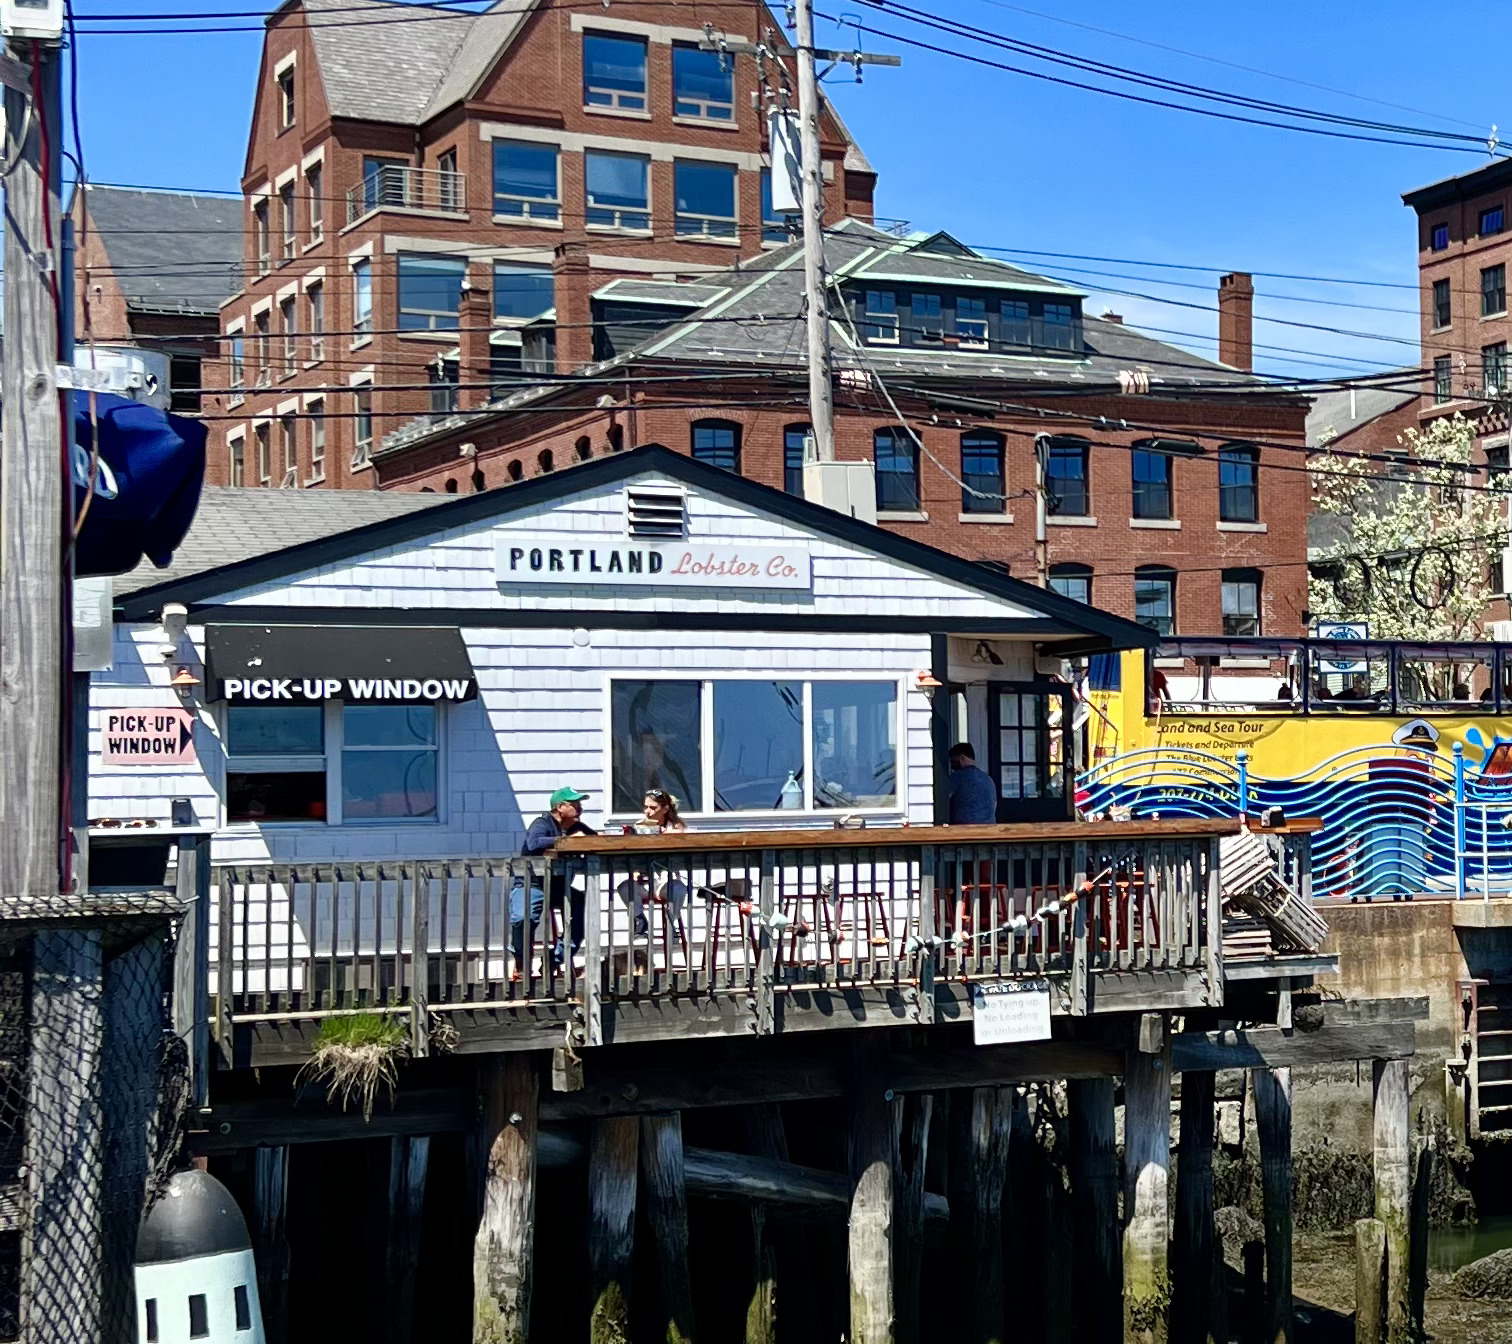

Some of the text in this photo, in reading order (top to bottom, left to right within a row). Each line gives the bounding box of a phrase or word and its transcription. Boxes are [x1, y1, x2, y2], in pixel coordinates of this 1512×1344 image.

[510, 547, 799, 578] PORTLAND Lobster Co.
[224, 678, 470, 700] PICK-UP WINDOW
[109, 715, 176, 734] PICK-UP
[1187, 720, 1212, 734] and
[1213, 721, 1235, 733] Sea
[1236, 720, 1264, 733] Tour
[109, 737, 177, 755] WINDOW
[1165, 740, 1194, 749] Tickets
[1194, 740, 1213, 749] and
[998, 999, 1024, 1010] Tying
[984, 1011, 1039, 1023] No Loading
[994, 1025, 1044, 1036] Unloading
